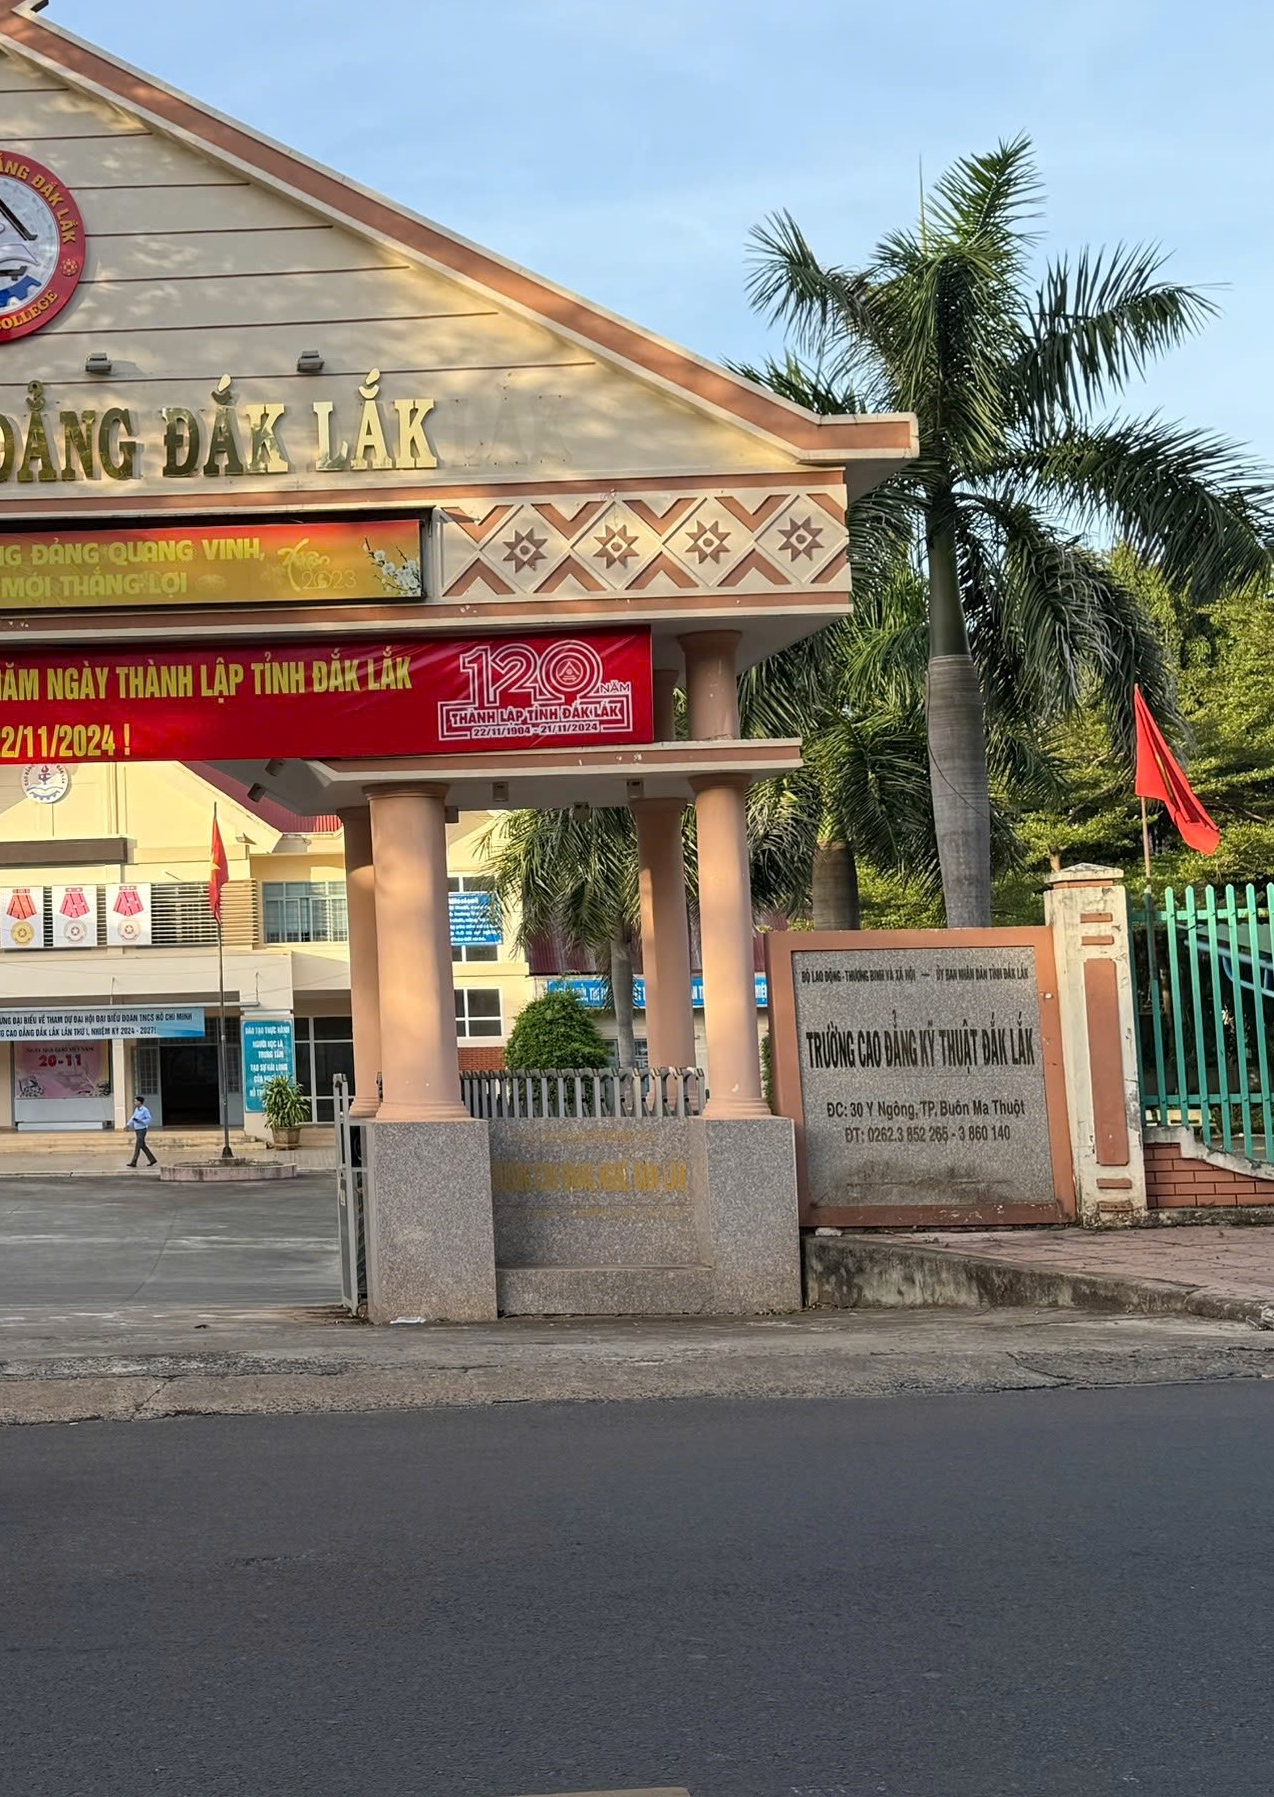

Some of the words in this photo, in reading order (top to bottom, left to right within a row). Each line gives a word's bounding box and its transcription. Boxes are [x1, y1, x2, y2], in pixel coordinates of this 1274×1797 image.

[31, 174, 63, 207] ĐẮK
[57, 208, 78, 244] LẮK
[161, 373, 288, 477] ĐẮK
[313, 368, 437, 472] LẮK
[31, 538, 100, 566] ĐẢNG
[108, 540, 193, 566] QUANG
[202, 537, 264, 562] VINH,
[1, 570, 51, 598] MỚI
[62, 566, 141, 596] THẮNG
[150, 571, 187, 599] LỢI
[302, 569, 357, 590] 2023
[46, 660, 109, 700] NGÀY
[116, 659, 193, 698] THÀNH
[200, 657, 244, 703] LẬP
[251, 651, 306, 695] TỈNH
[312, 647, 361, 693] ĐẮK
[367, 645, 413, 690] LẮK
[460, 639, 604, 707] 120
[600, 679, 631, 694] NĂM
[451, 707, 497, 727] THÀNH
[500, 706, 525, 726] LẬP
[527, 704, 559, 723] TỈNH
[562, 700, 593, 720] ĐẮK
[595, 698, 621, 719] LẮK
[472, 726, 531, 739] 22/11/1904
[540, 722, 599, 735] 21/11/2024
[806, 1021, 855, 1069] TRƯỜNG
[857, 1031, 881, 1068] CAO
[884, 1009, 917, 1067] ĐẲNG
[939, 1019, 979, 1074] THUẬT
[982, 1012, 1008, 1066] ĐẮK
[1010, 1011, 1035, 1065] LẮK
[39, 1054, 82, 1067] 20-11
[827, 1102, 848, 1118] ĐC:
[850, 1101, 863, 1118] 30
[867, 1102, 874, 1117] Y
[940, 1100, 970, 1117] Buôn
[972, 1101, 989, 1116] Ma
[993, 1099, 1025, 1117] Thuột
[845, 1128, 867, 1144] ĐT:
[906, 1126, 926, 1142] 852
[958, 1126, 965, 1142] 3
[991, 1125, 1010, 1140] 140
